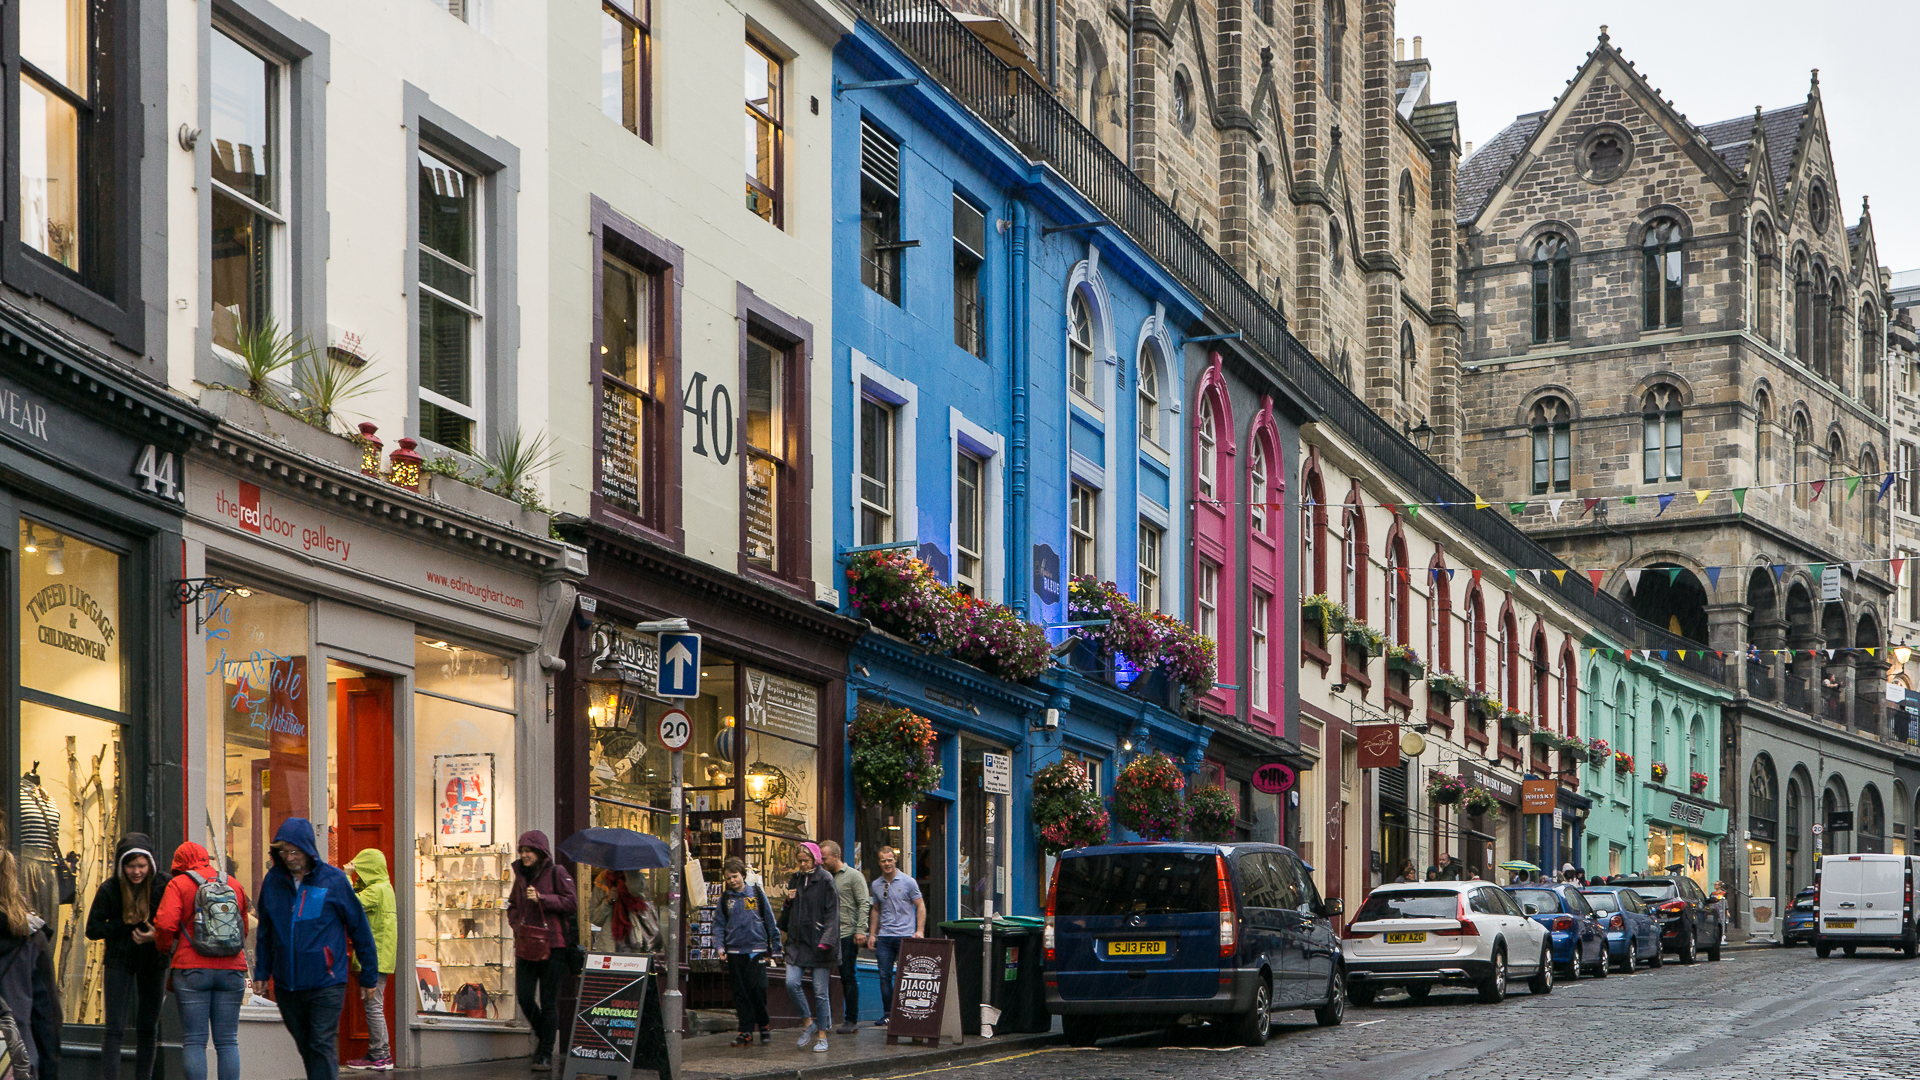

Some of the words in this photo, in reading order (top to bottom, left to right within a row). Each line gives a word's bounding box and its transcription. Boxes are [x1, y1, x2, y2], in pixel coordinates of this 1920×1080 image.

[612, 393, 632, 410] HOPE
[682, 371, 733, 465] 40
[613, 468, 637, 484] Scottish
[216, 489, 238, 518] the
[241, 502, 260, 527] red
[263, 507, 296, 538] door
[302, 525, 351, 561] gallery
[426, 571, 524, 609] www.edinburghart.com
[1044, 577, 1060, 595] BLEUE
[26, 583, 66, 623] TWEED
[69, 584, 115, 646] LUGGAGE
[69, 613, 77, 629] &
[38, 625, 106, 662] CHILDRENSWEAR
[663, 722, 688, 738] 20
[1473, 770, 1483, 784] THE
[1482, 773, 1500, 791] WHISKY
[1500, 781, 1513, 796] SHOP
[1409, 933, 1424, 941] AZG
[1115, 943, 1137, 953] SJ13
[1139, 942, 1160, 952] FRD
[900, 979, 940, 994] DIAGON
[906, 990, 932, 999] HOUSE
[590, 1007, 638, 1018] AFFORDABLE
[610, 1019, 636, 1028] DESIGN
[580, 1048, 598, 1058] THIS
[599, 1050, 617, 1060] WAY
